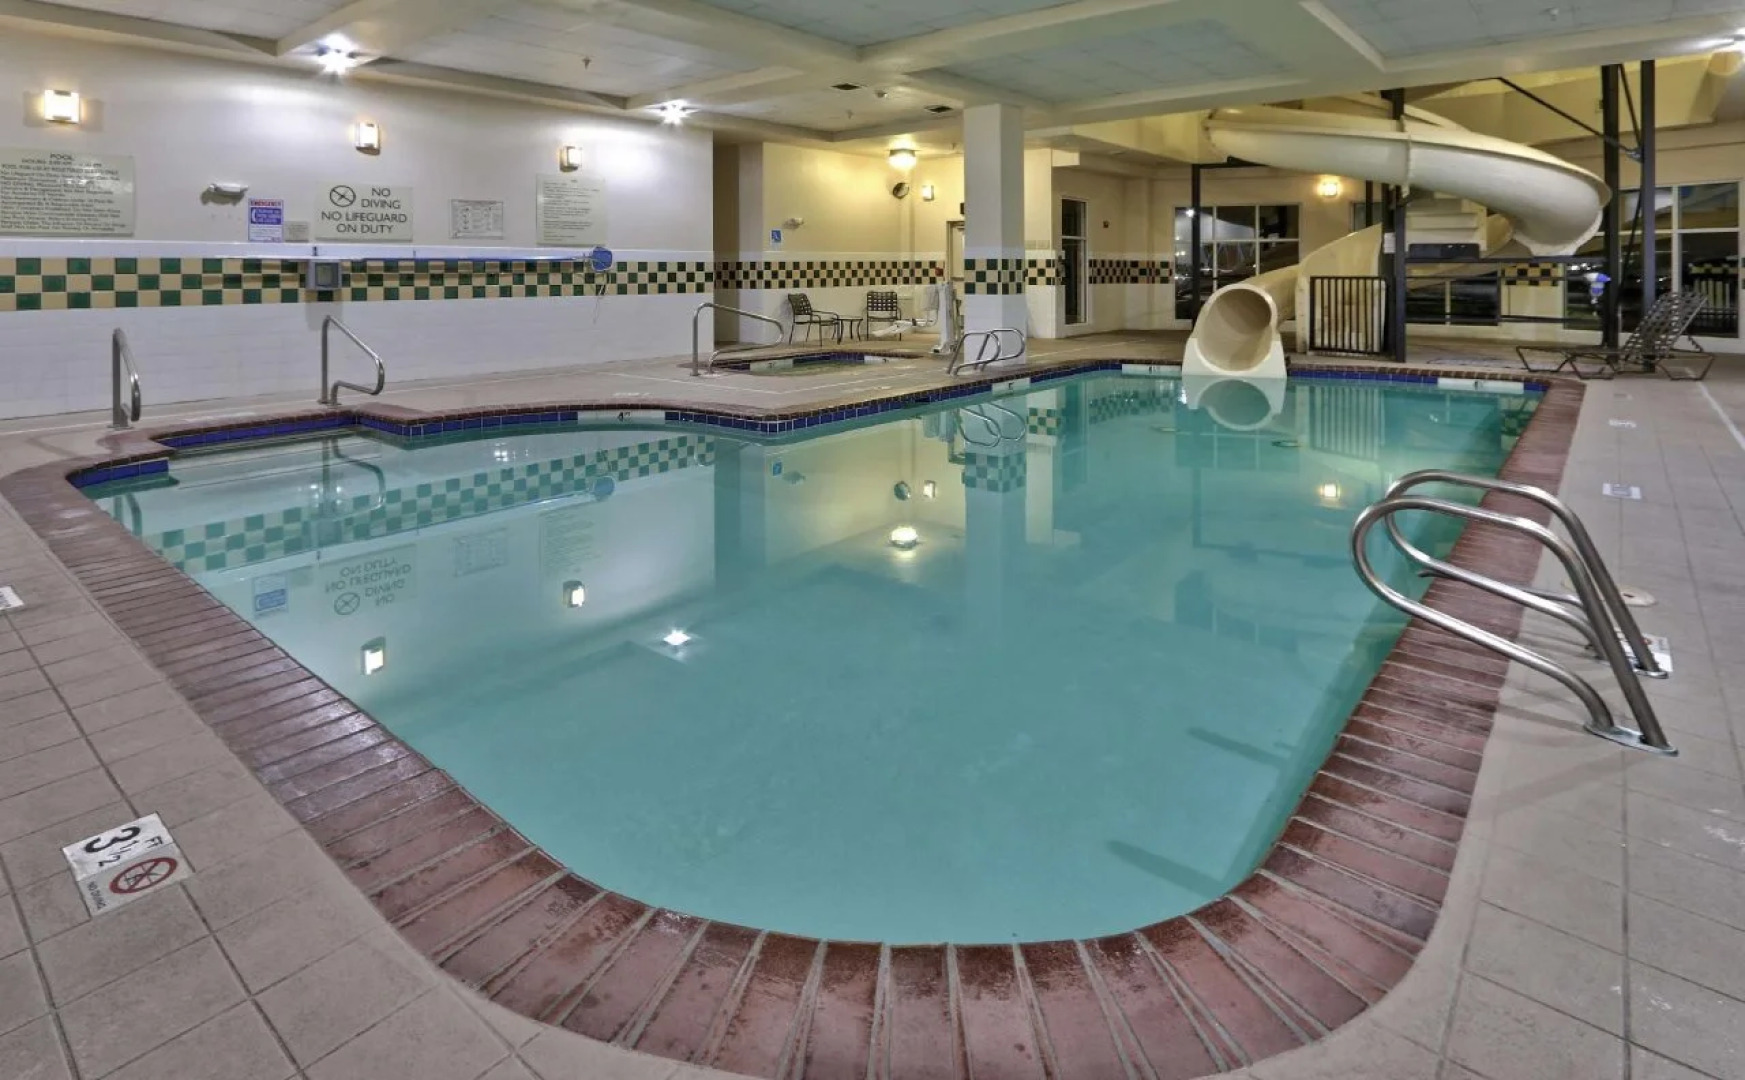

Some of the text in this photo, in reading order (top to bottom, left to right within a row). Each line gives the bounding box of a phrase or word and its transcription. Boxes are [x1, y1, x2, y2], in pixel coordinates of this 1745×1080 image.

[50, 153, 74, 161] POOL
[371, 187, 391, 197] NO
[361, 199, 401, 209] DIVING
[321, 211, 407, 223] NO LIFEGUARD
[336, 223, 394, 234] ON DUTY
